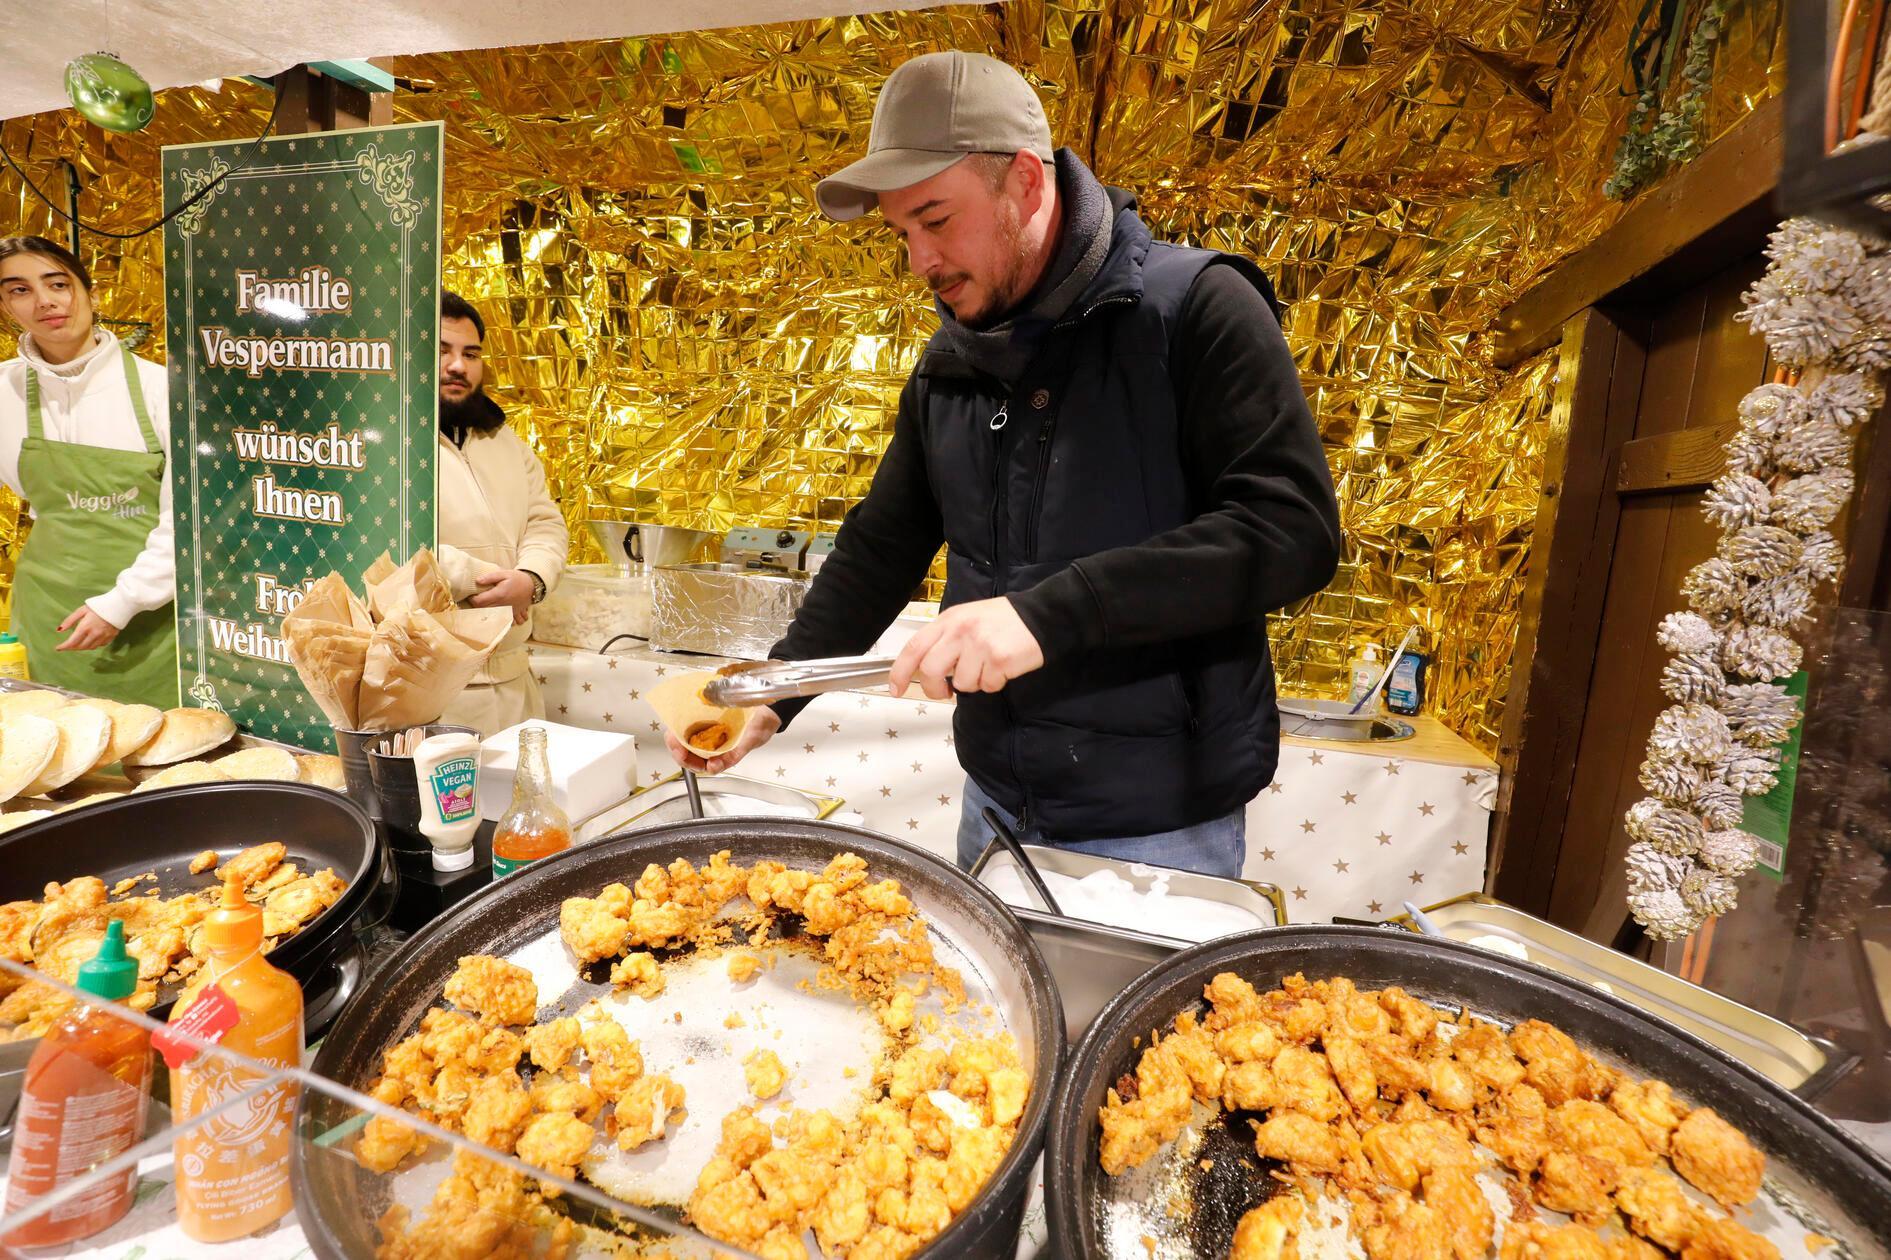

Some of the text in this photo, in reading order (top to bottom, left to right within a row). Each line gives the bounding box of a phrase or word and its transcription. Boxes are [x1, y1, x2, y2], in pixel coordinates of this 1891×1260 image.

[237, 268, 351, 311] Familie
[200, 328, 393, 376] Vespermann
[233, 424, 365, 468] wünscht
[66, 490, 128, 512] Veggie
[253, 476, 344, 523] Ihnen
[208, 618, 297, 664] Weihn
[442, 762, 471, 775] HEINZ
[443, 772, 472, 787] VEGAN
[240, 1199, 264, 1215] 730
